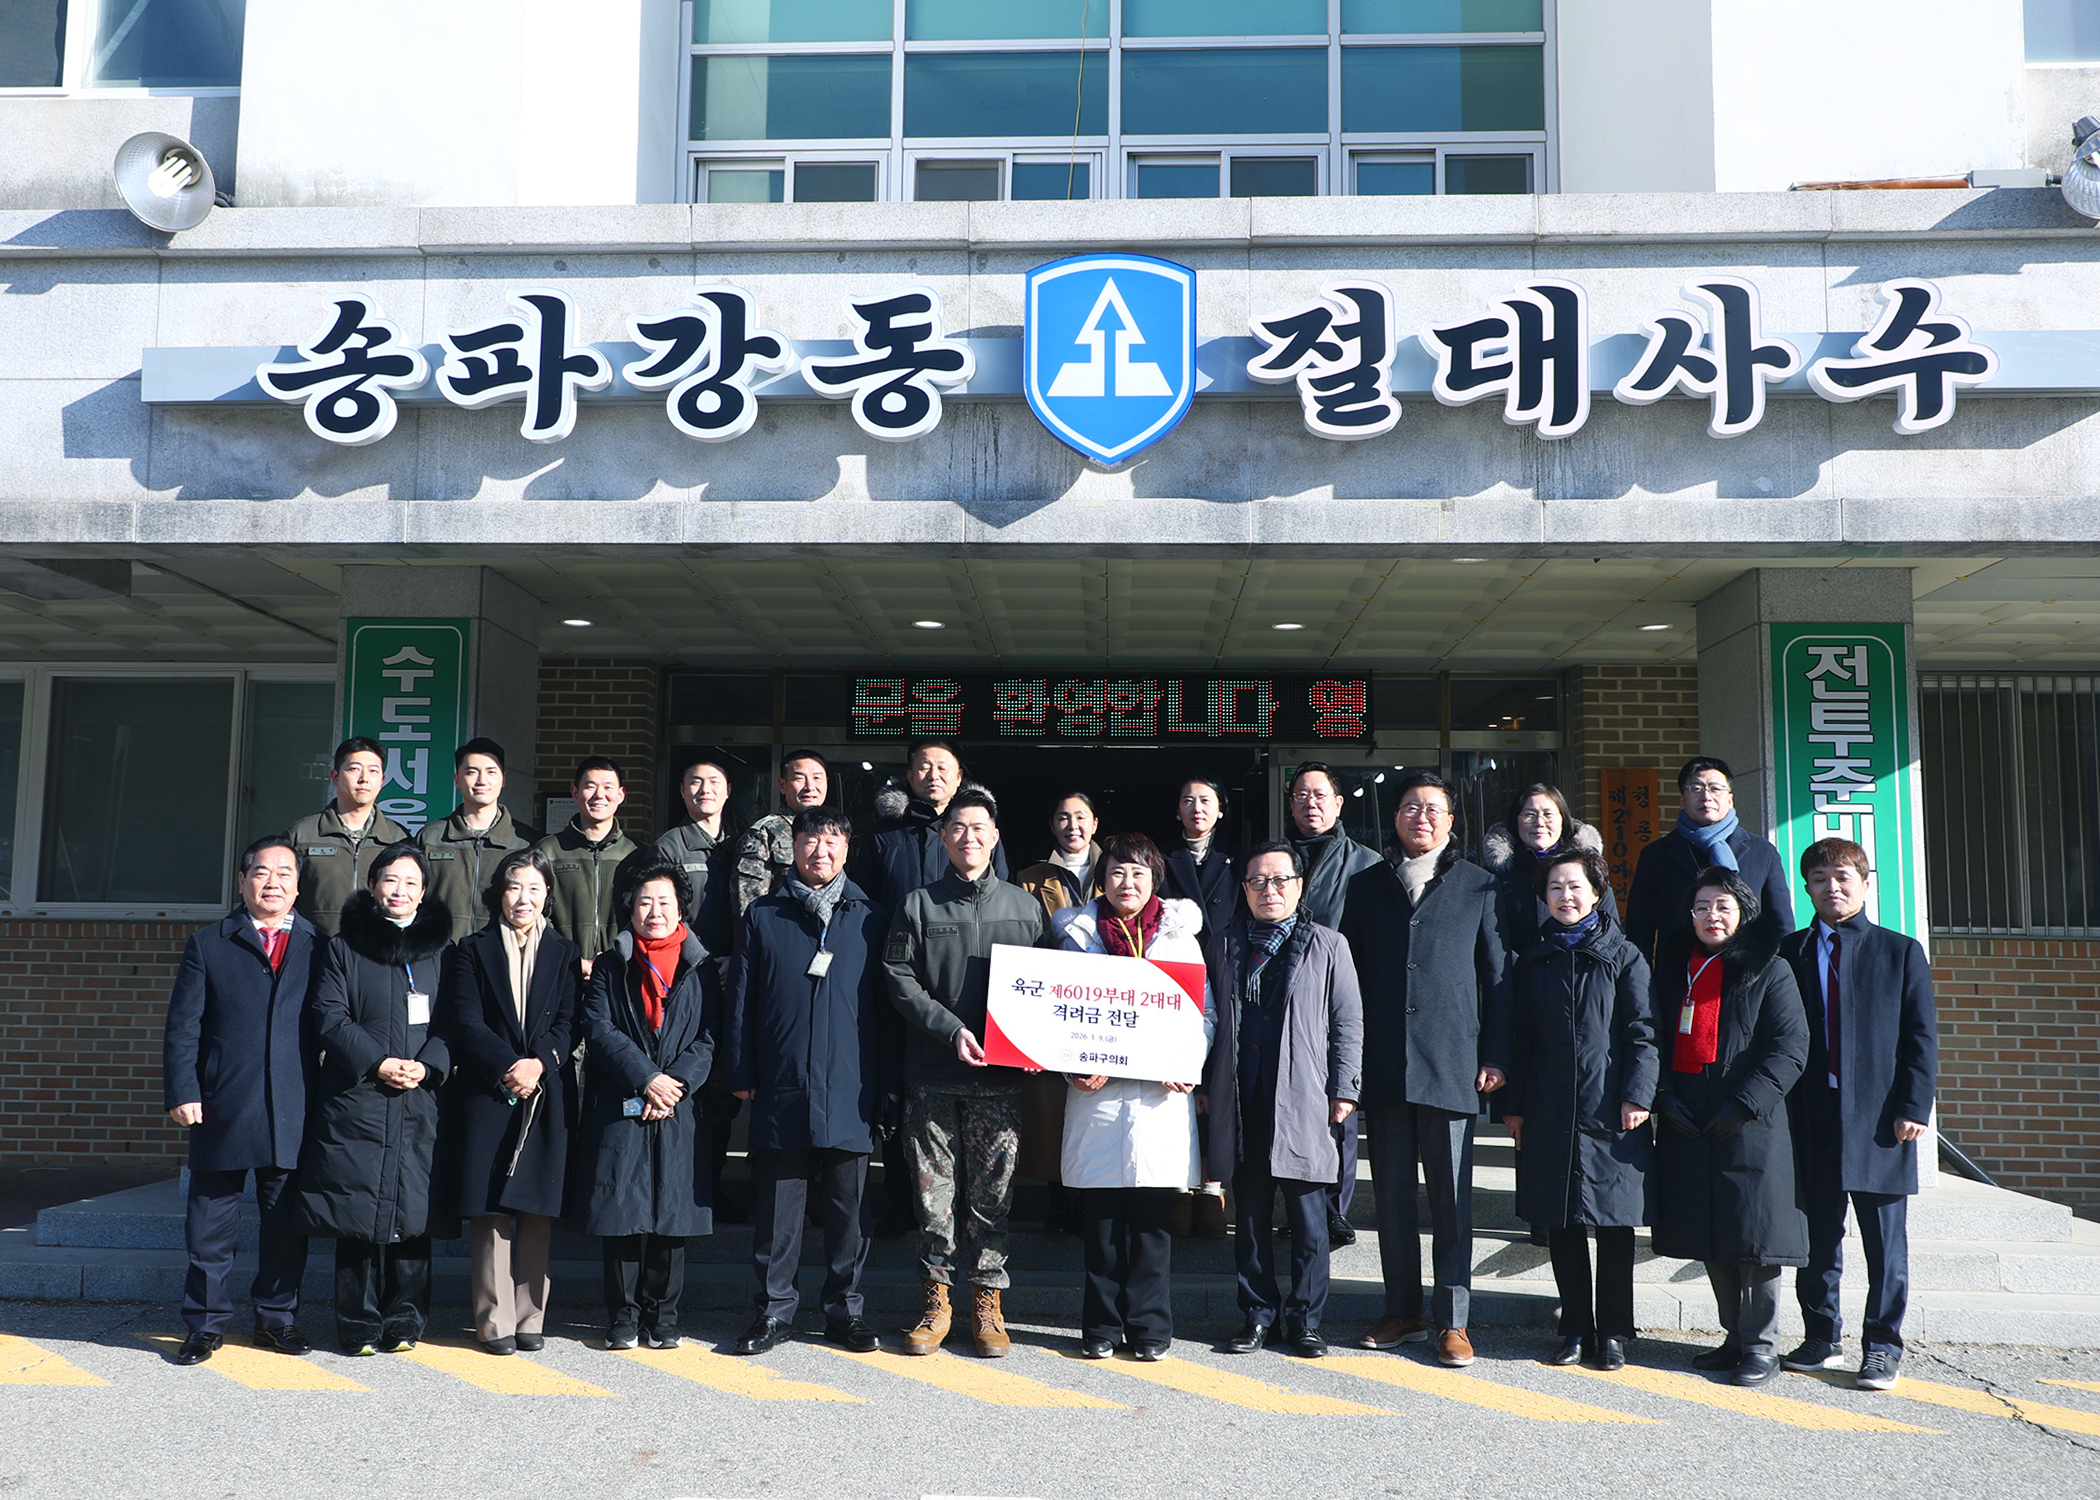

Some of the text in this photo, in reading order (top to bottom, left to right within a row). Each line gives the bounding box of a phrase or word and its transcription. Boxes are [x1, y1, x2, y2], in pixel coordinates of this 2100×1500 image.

[260, 281, 1992, 440] 송파강동 절대사수
[993, 678, 1281, 737] 환영합니다
[1011, 977, 1182, 1011] 육군 제6019부대 2대대
[1052, 1003, 1140, 1029] 격려금 전달
[1079, 1051, 1128, 1066] 송파구의회
